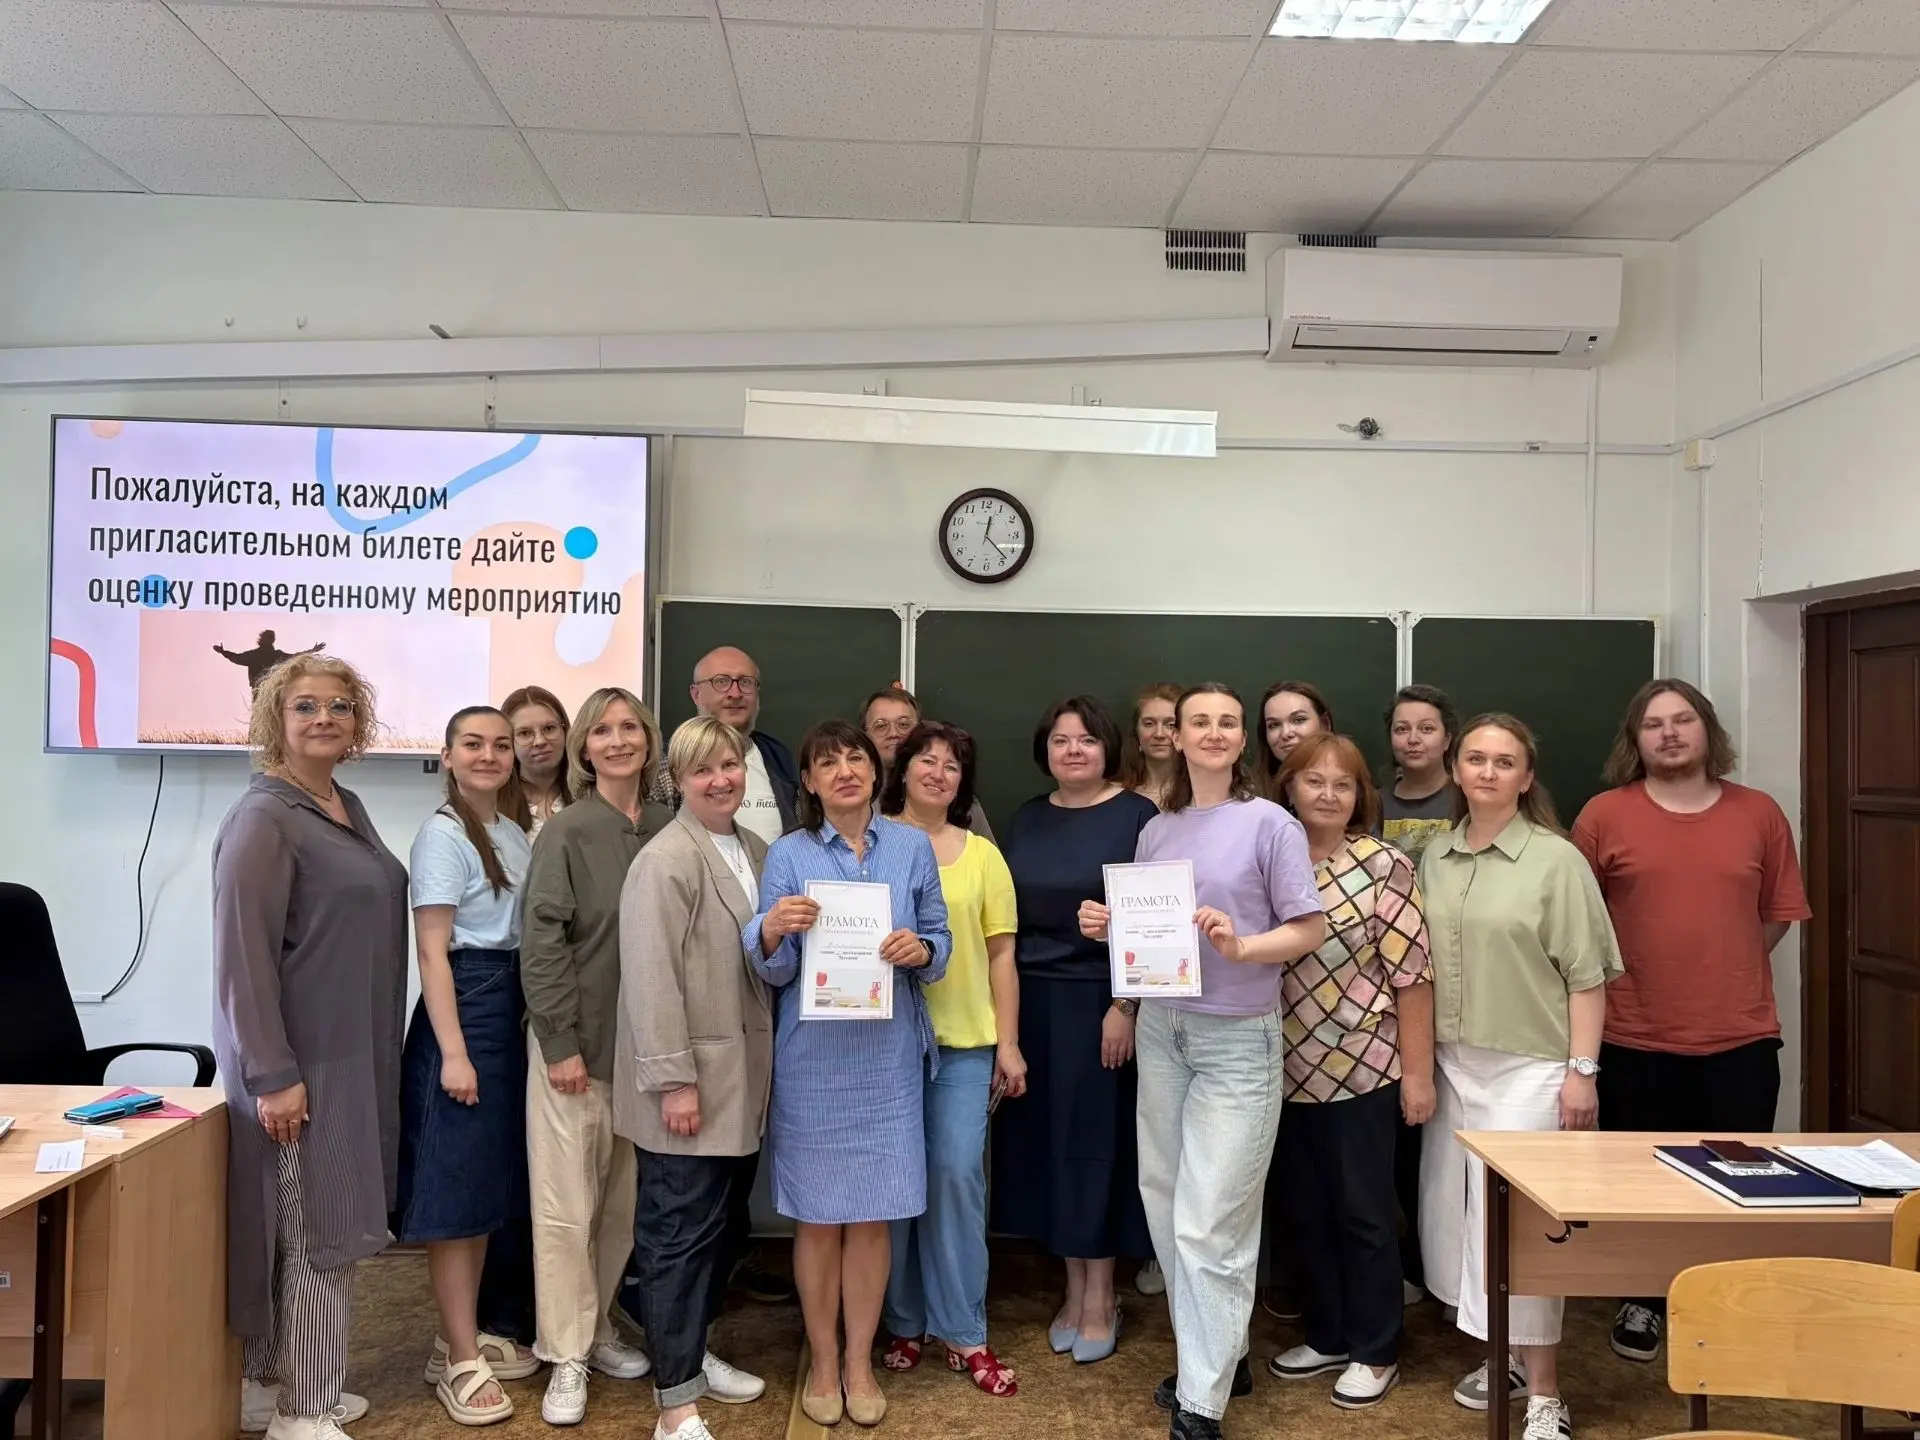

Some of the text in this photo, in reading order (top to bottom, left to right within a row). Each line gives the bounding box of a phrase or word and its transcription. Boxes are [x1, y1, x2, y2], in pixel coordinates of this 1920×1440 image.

[92, 468, 447, 514] Пожалуйста, на каждом
[981, 500, 992, 509] 12
[965, 505, 975, 514] 11
[952, 517, 964, 526] 10
[1009, 515, 1016, 524] 2
[952, 532, 959, 541] 9
[1012, 531, 1019, 540] 3
[91, 526, 554, 566] пригласительном билете дайте
[956, 547, 963, 556] 8
[967, 558, 974, 567] 7
[983, 562, 990, 571] 6
[998, 558, 1005, 566] 5
[89, 579, 620, 619] оценку проведенному мероприятию
[1121, 896, 1181, 908] ГРАМОТА
[819, 915, 879, 928] ГРАМОТА
